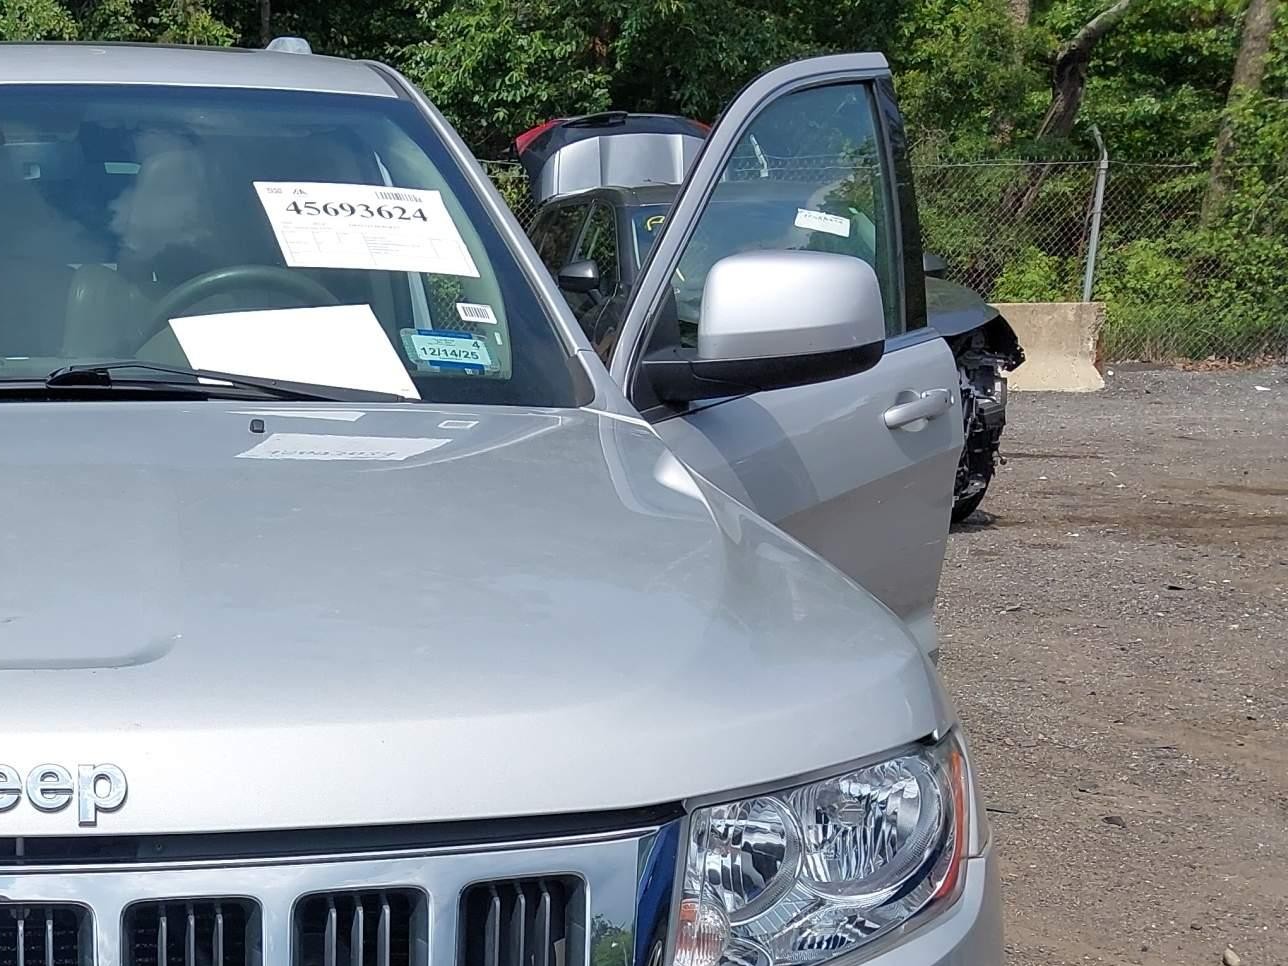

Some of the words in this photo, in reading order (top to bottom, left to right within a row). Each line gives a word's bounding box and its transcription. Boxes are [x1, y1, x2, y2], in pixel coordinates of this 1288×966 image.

[285, 200, 428, 222] 45693624
[472, 341, 481, 349] 4
[420, 346, 480, 360] 12/14/25
